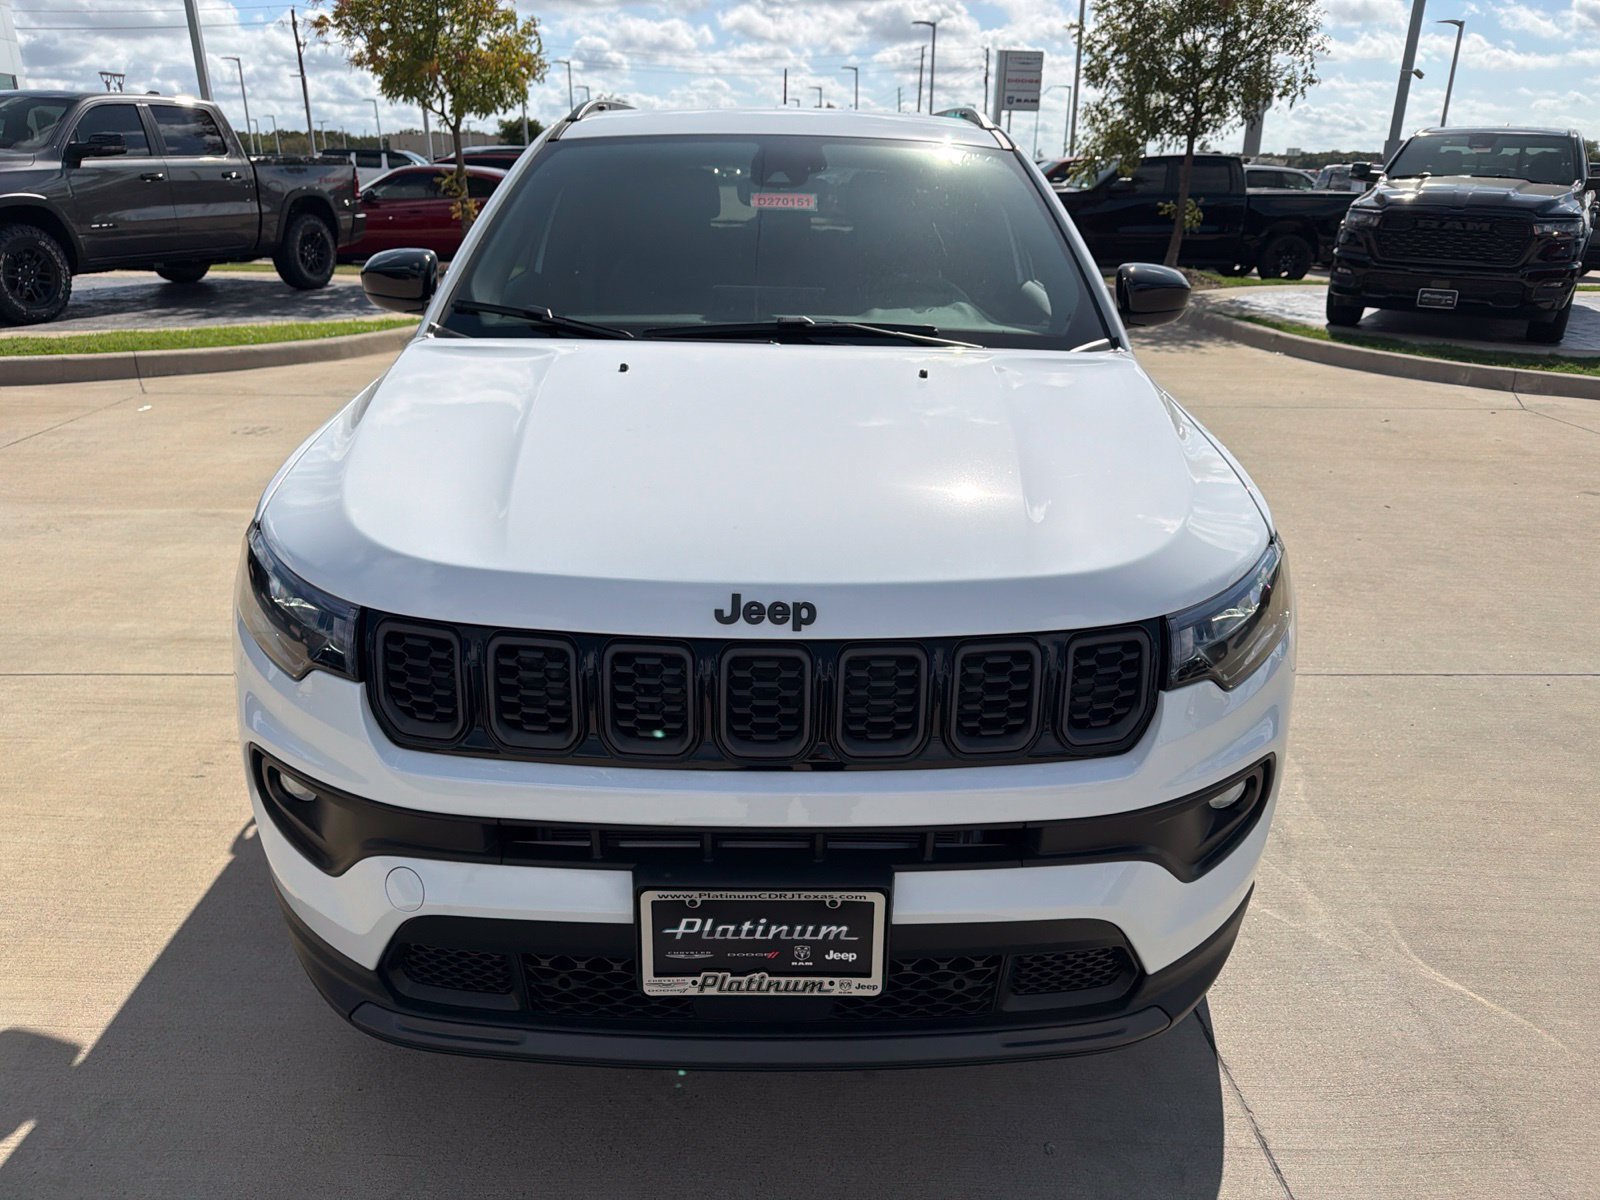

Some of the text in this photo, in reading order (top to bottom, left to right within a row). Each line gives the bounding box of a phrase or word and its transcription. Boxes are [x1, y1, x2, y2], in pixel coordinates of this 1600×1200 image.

[758, 197, 810, 206] D270151
[1417, 219, 1490, 231] RAM
[714, 593, 817, 631] Jeep
[657, 892, 867, 900] www.PlatinumCDRJTexas.com
[662, 918, 859, 940] Platinum
[825, 950, 857, 962] Jeep
[696, 974, 835, 993] Platinum
[855, 983, 878, 991] Jeep
